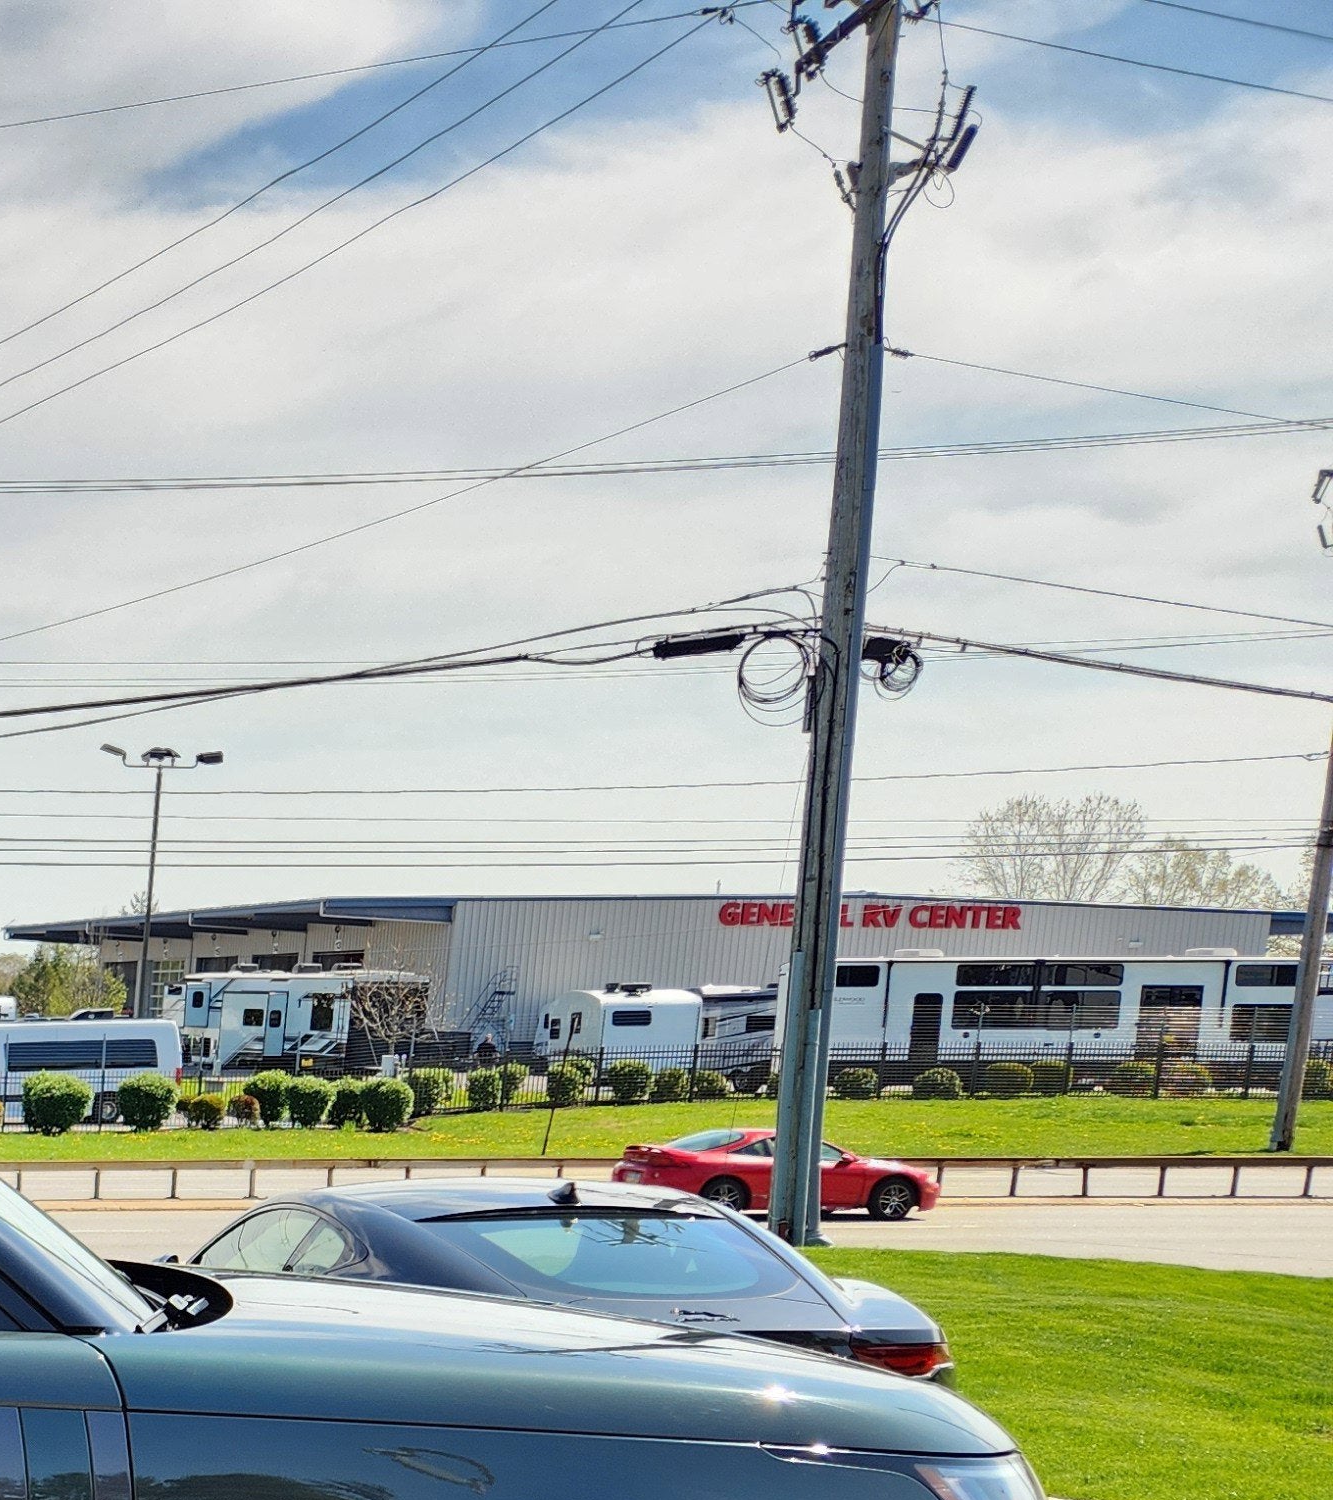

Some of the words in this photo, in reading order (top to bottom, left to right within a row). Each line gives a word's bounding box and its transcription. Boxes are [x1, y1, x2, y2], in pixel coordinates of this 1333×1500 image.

[718, 902, 854, 928] GENEL
[862, 904, 903, 928] RV
[908, 904, 1022, 930] CENTER
